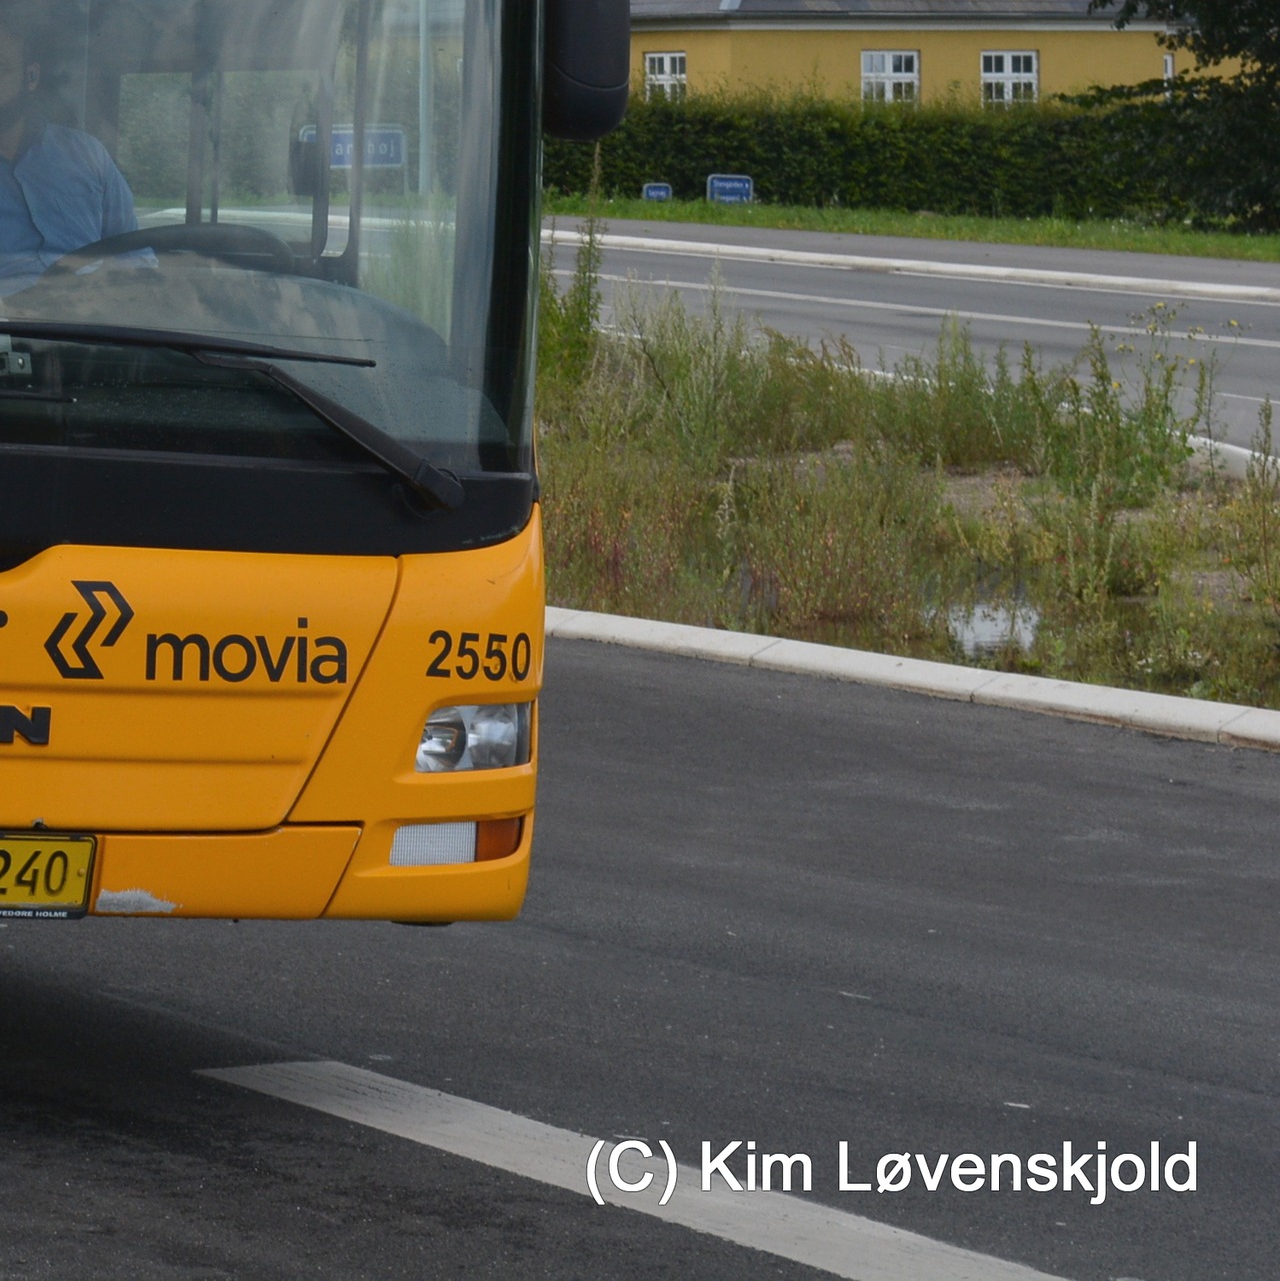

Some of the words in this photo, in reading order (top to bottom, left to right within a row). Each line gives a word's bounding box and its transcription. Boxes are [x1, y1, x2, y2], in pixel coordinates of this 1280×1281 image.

[145, 617, 348, 684] movia
[425, 630, 532, 682] 2550
[35, 910, 68, 918] HOLME
